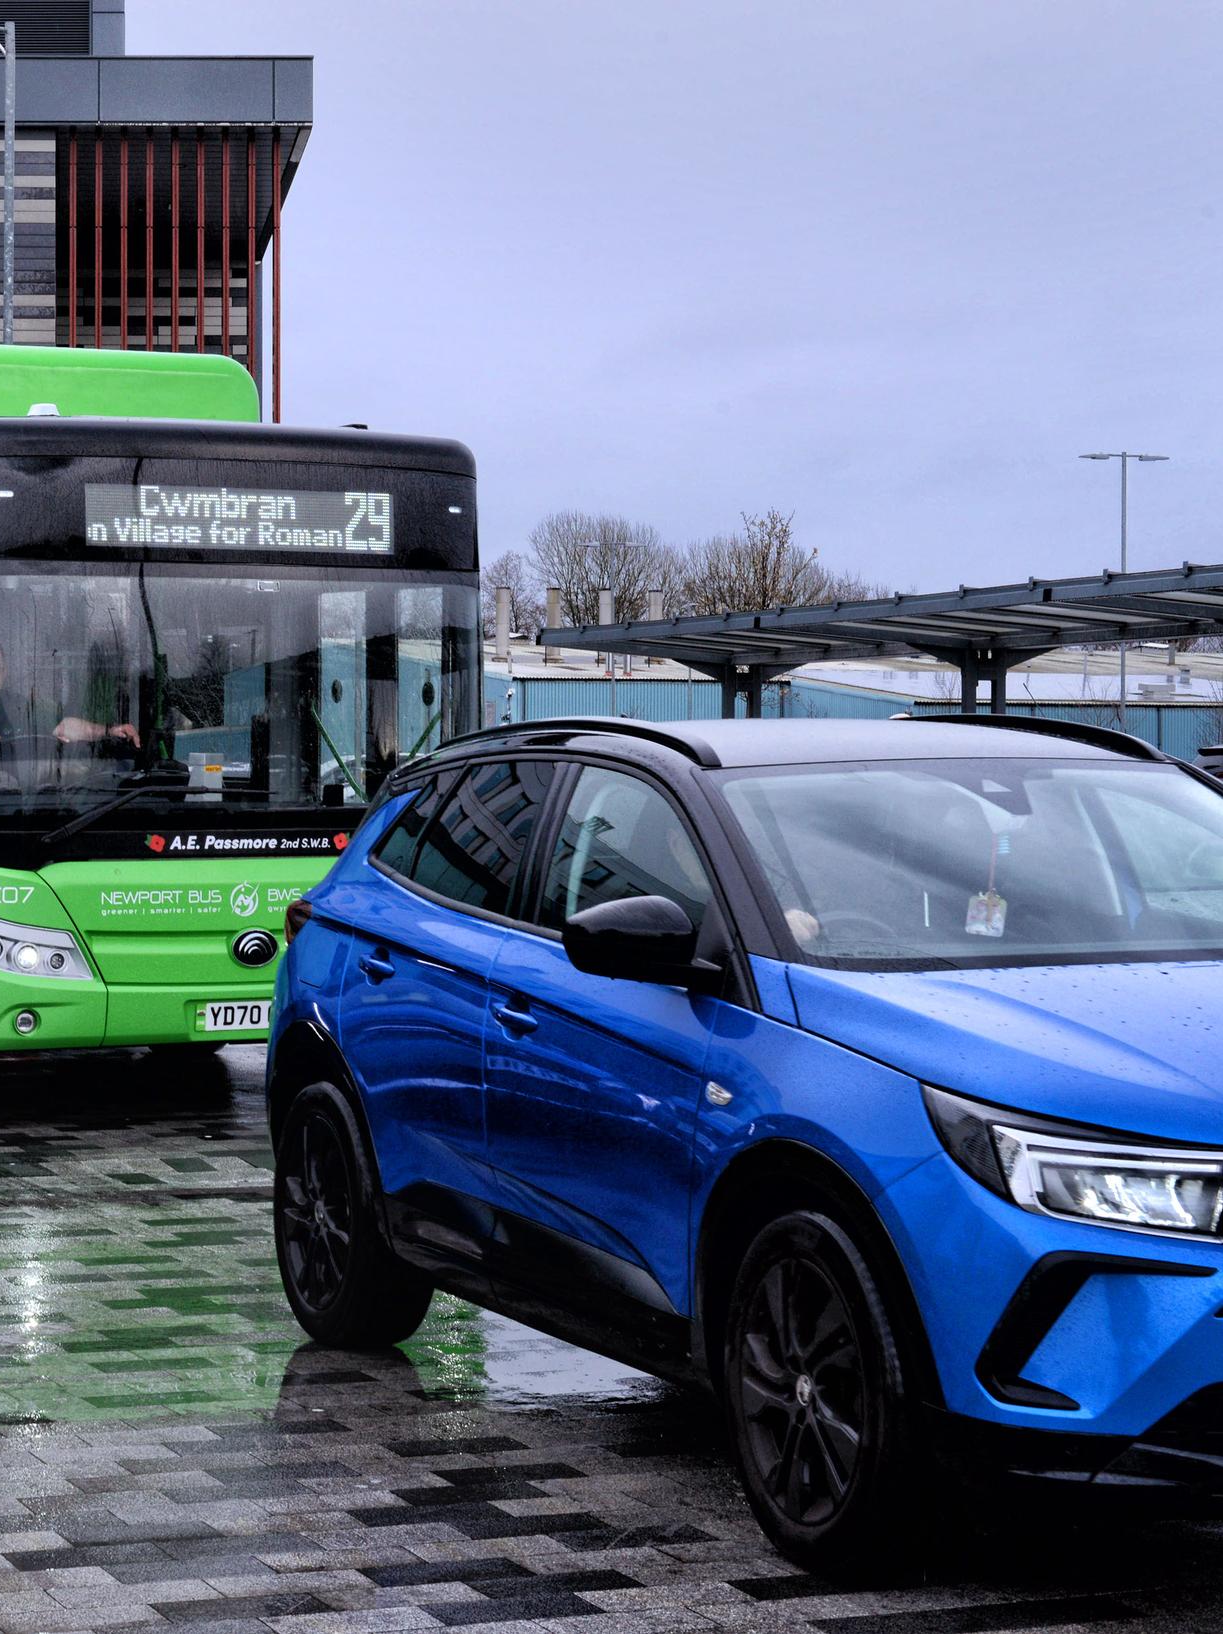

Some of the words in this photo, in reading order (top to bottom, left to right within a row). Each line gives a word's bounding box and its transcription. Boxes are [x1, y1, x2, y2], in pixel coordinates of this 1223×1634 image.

[140, 485, 296, 520] Cwmbran
[344, 491, 391, 550] 29
[114, 517, 202, 544] Village
[209, 520, 251, 545] for
[258, 521, 343, 547] Roman
[169, 835, 200, 850] A.E.
[204, 835, 278, 851] Passmore
[280, 838, 300, 849] 2nd
[301, 838, 331, 849] S.W.B.
[100, 890, 184, 906] NEWPORT
[188, 889, 223, 904] BUS
[267, 887, 304, 901] BWS
[101, 908, 138, 917] greener
[150, 906, 186, 915] smarter
[197, 905, 222, 914] safer
[210, 1005, 262, 1027] YD70
